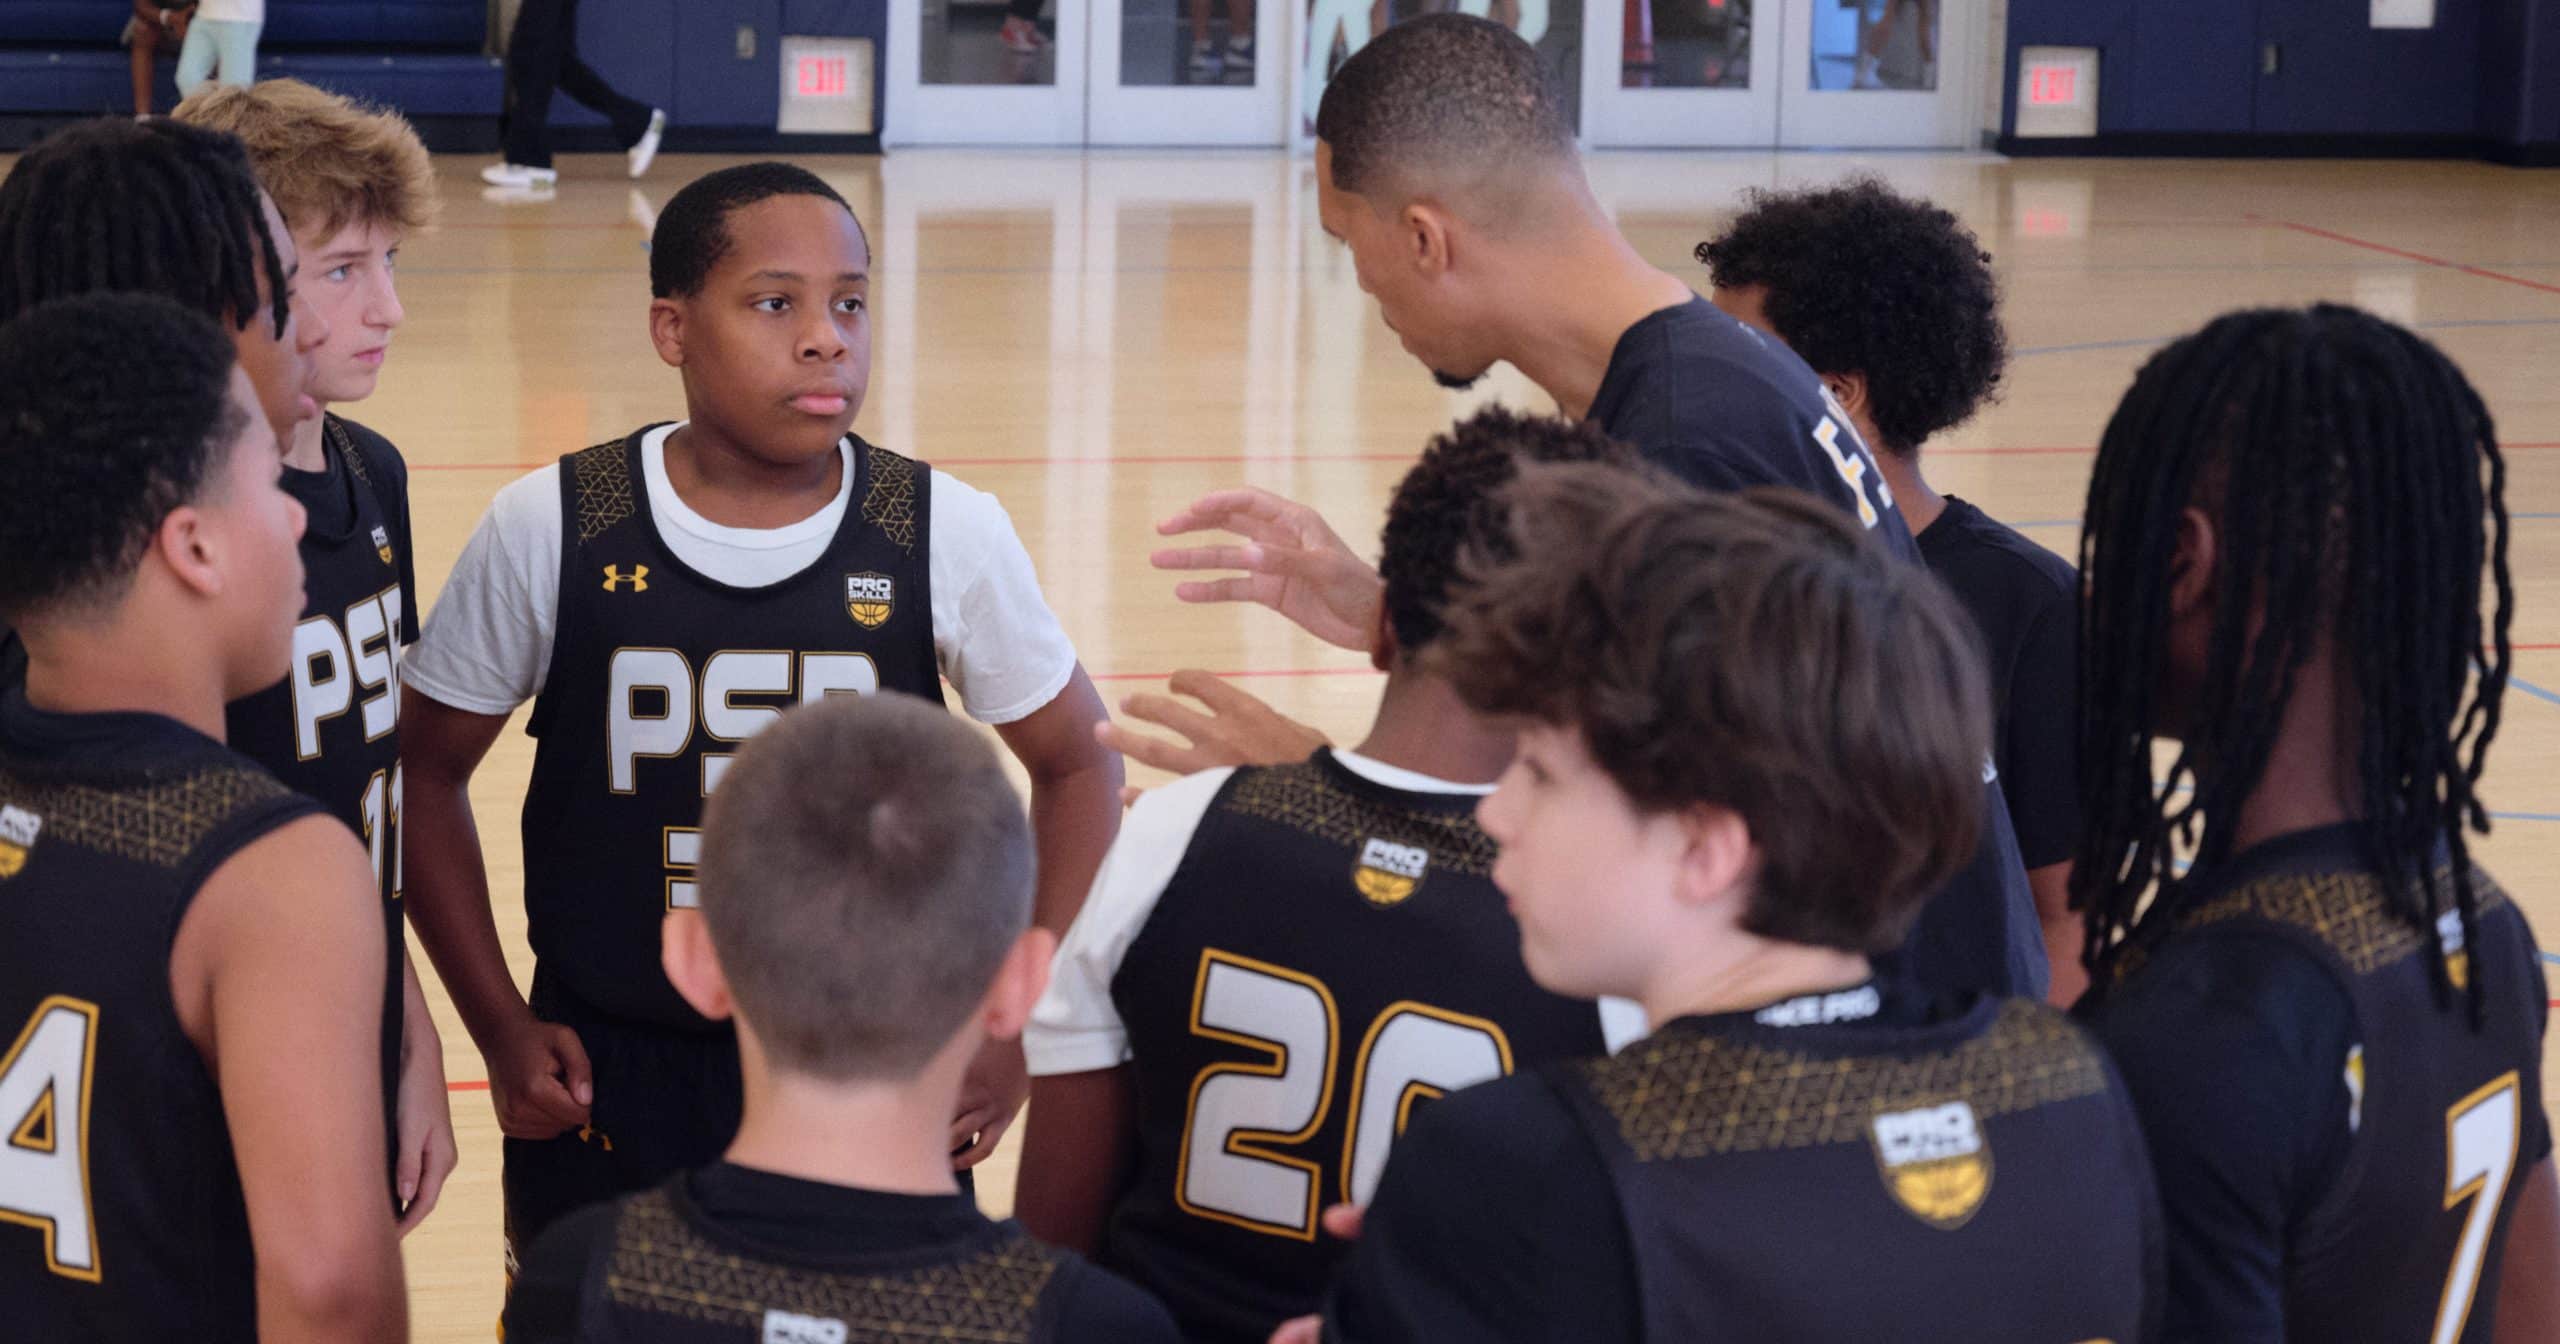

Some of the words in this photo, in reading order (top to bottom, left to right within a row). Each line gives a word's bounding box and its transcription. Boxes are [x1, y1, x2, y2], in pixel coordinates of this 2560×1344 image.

[847, 577, 892, 592] PRO
[848, 590, 892, 601] SKILLS
[361, 756, 404, 898] 11
[1362, 837, 1429, 867] PRO
[2441, 1067, 2522, 1344] 7
